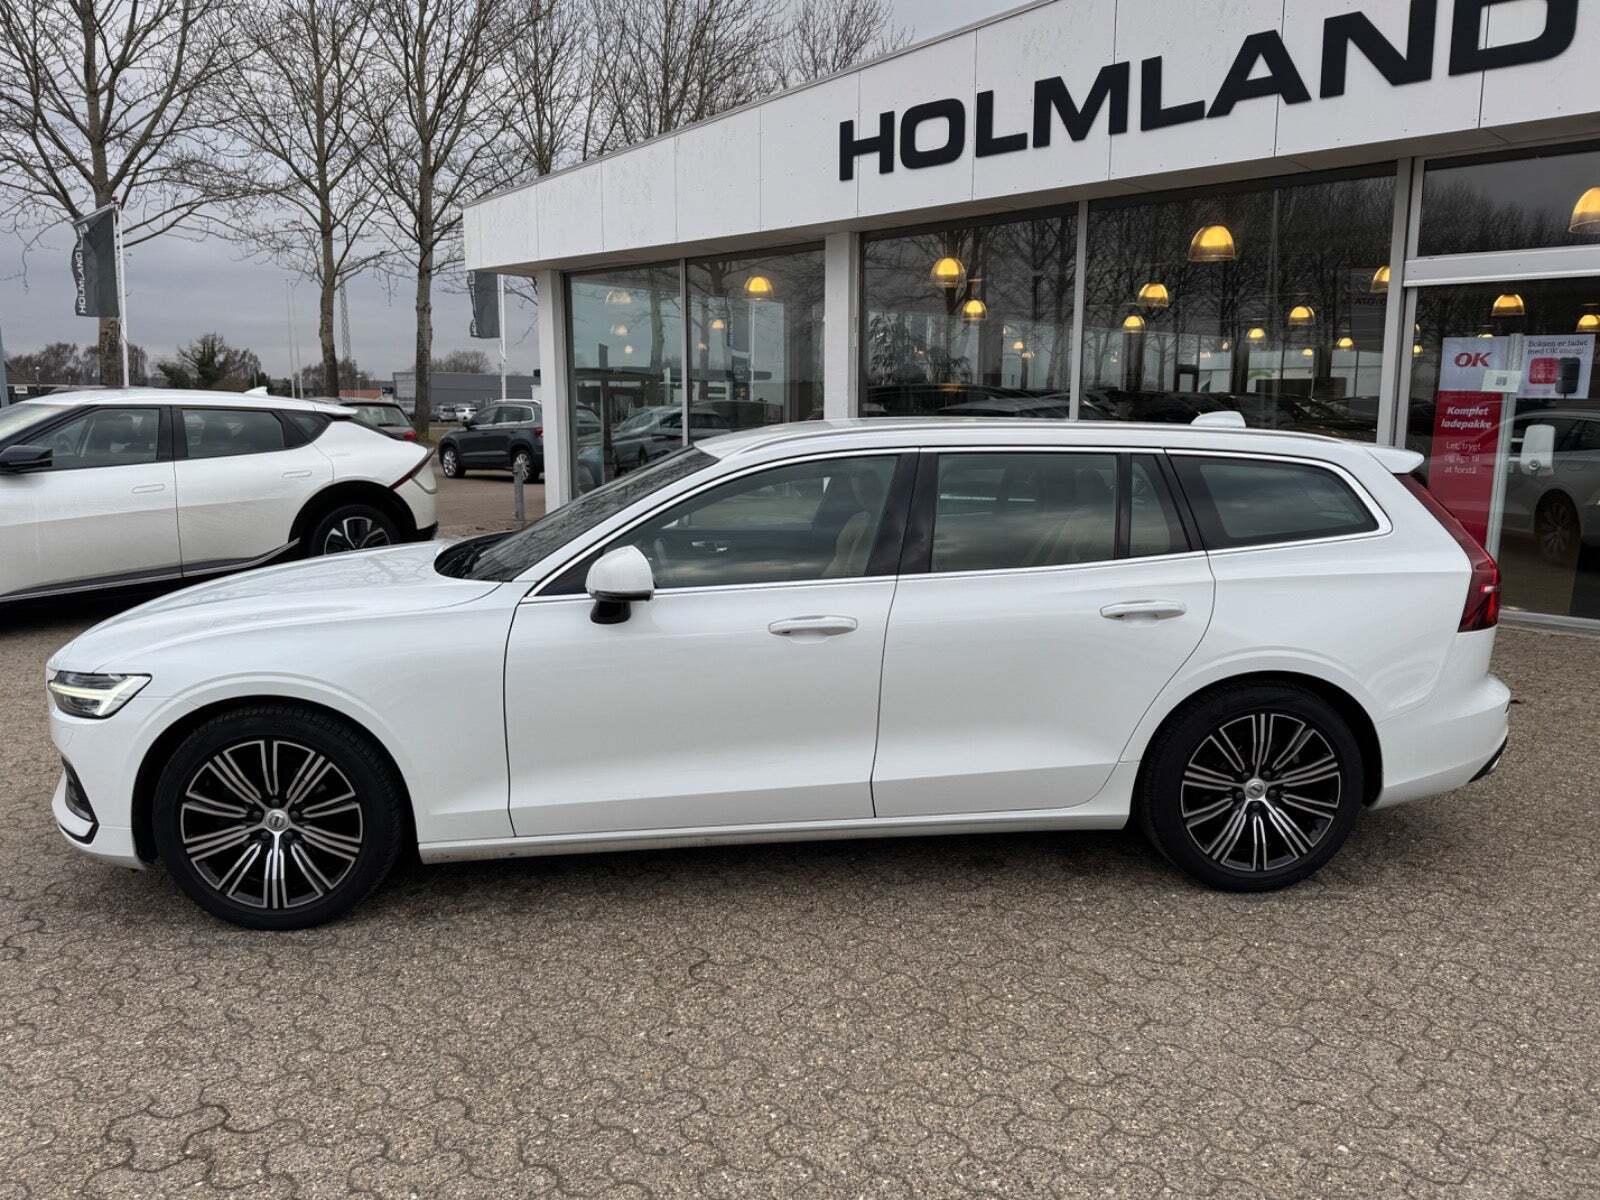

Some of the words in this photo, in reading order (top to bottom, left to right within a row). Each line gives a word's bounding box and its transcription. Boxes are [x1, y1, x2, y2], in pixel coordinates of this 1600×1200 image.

[839, 0, 1578, 181] HOLMLAND
[75, 252, 87, 314] HOLMLAND
[1454, 351, 1492, 367] OK
[1446, 405, 1489, 417] Komplet
[1440, 418, 1492, 430] ladepakke
